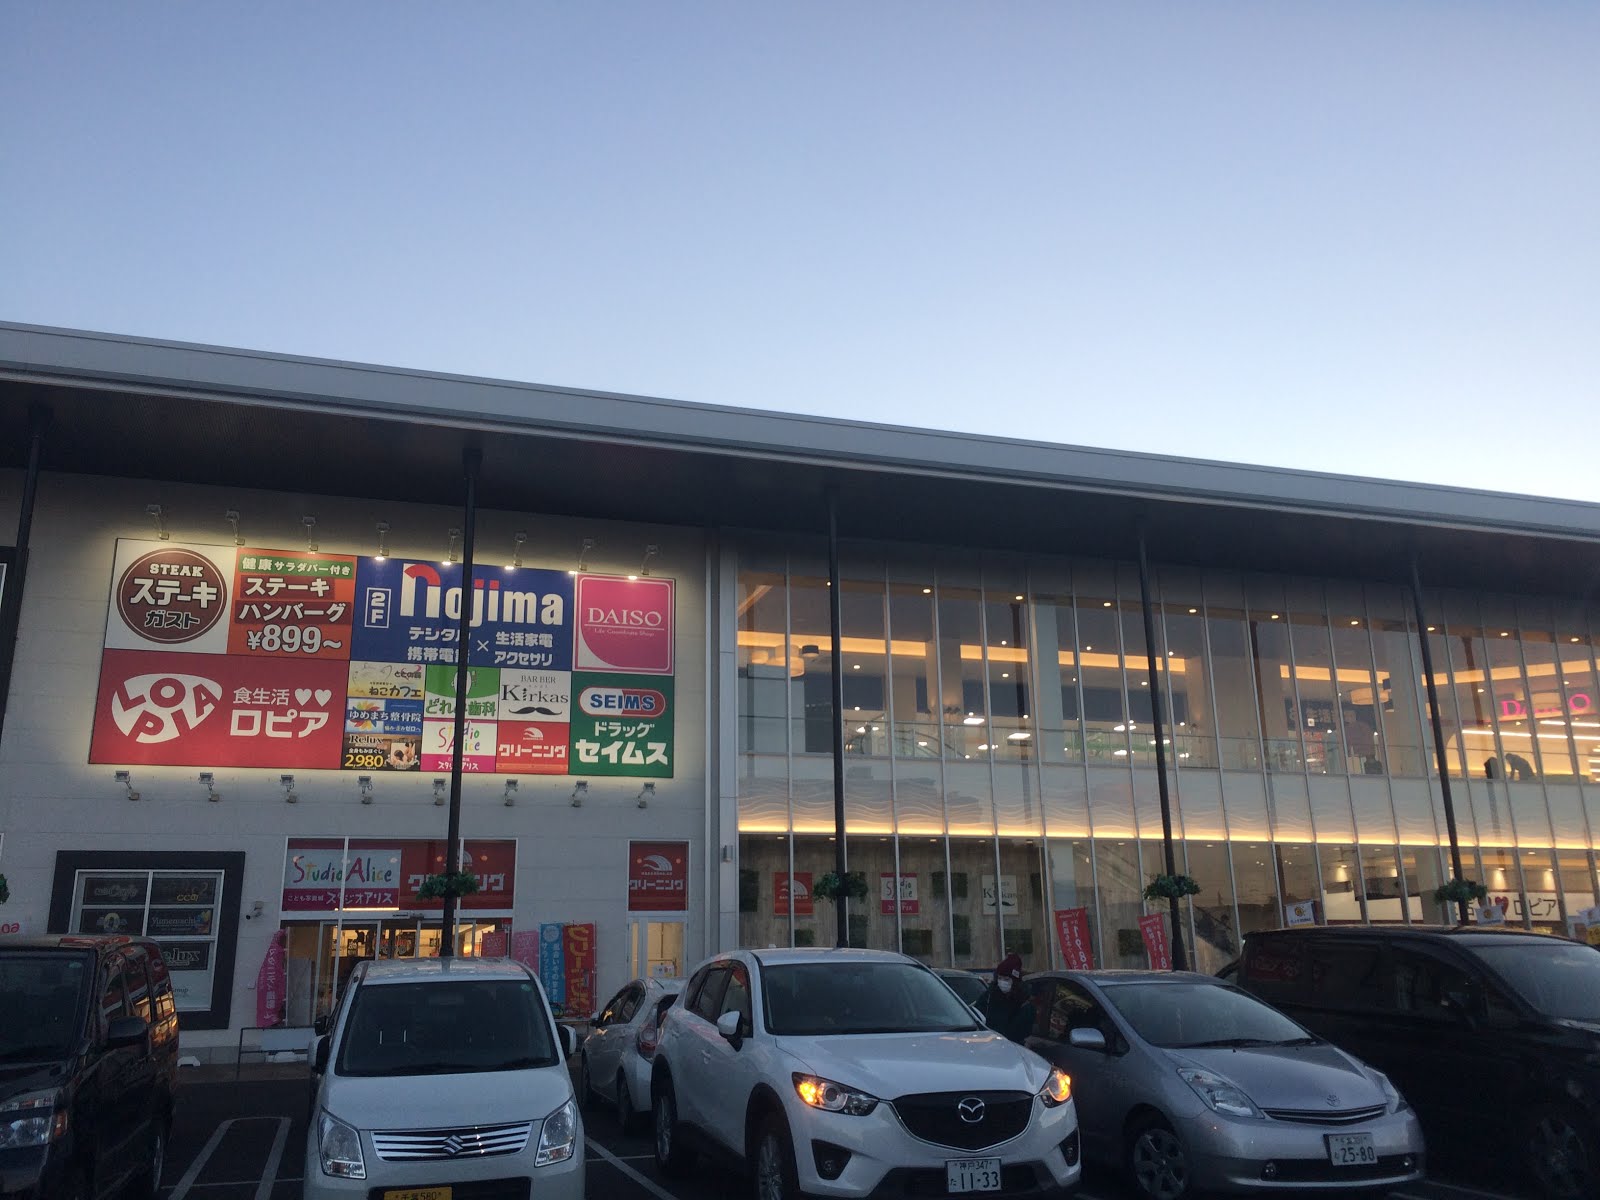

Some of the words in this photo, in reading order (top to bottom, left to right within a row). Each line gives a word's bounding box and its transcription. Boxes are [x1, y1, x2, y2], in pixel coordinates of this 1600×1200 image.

[150, 564, 204, 578] STEAK
[130, 578, 218, 609] ステーキ
[245, 578, 330, 597] ステーキ
[400, 563, 564, 628] nojima
[144, 610, 200, 630] ガスト
[239, 602, 346, 622] ハンバーグ
[588, 607, 662, 626] DAISO
[496, 631, 553, 648] 生活家電
[494, 651, 553, 667] アクセサリ
[232, 688, 290, 706] 食生活
[369, 686, 422, 698] ねこカフェ
[502, 684, 568, 704] Kirkas
[426, 698, 496, 716] どれ歯科
[589, 694, 655, 712] SEIMS
[230, 710, 330, 738] ロピア
[350, 710, 422, 722] ゆめまち整骨院
[348, 734, 384, 744] Relux
[594, 722, 655, 738] ドラッグ
[499, 744, 566, 758] クリーニング
[575, 738, 668, 766] セイムス
[292, 856, 343, 884] Studio
[345, 857, 392, 884] Alice
[629, 879, 684, 890] クリーニング
